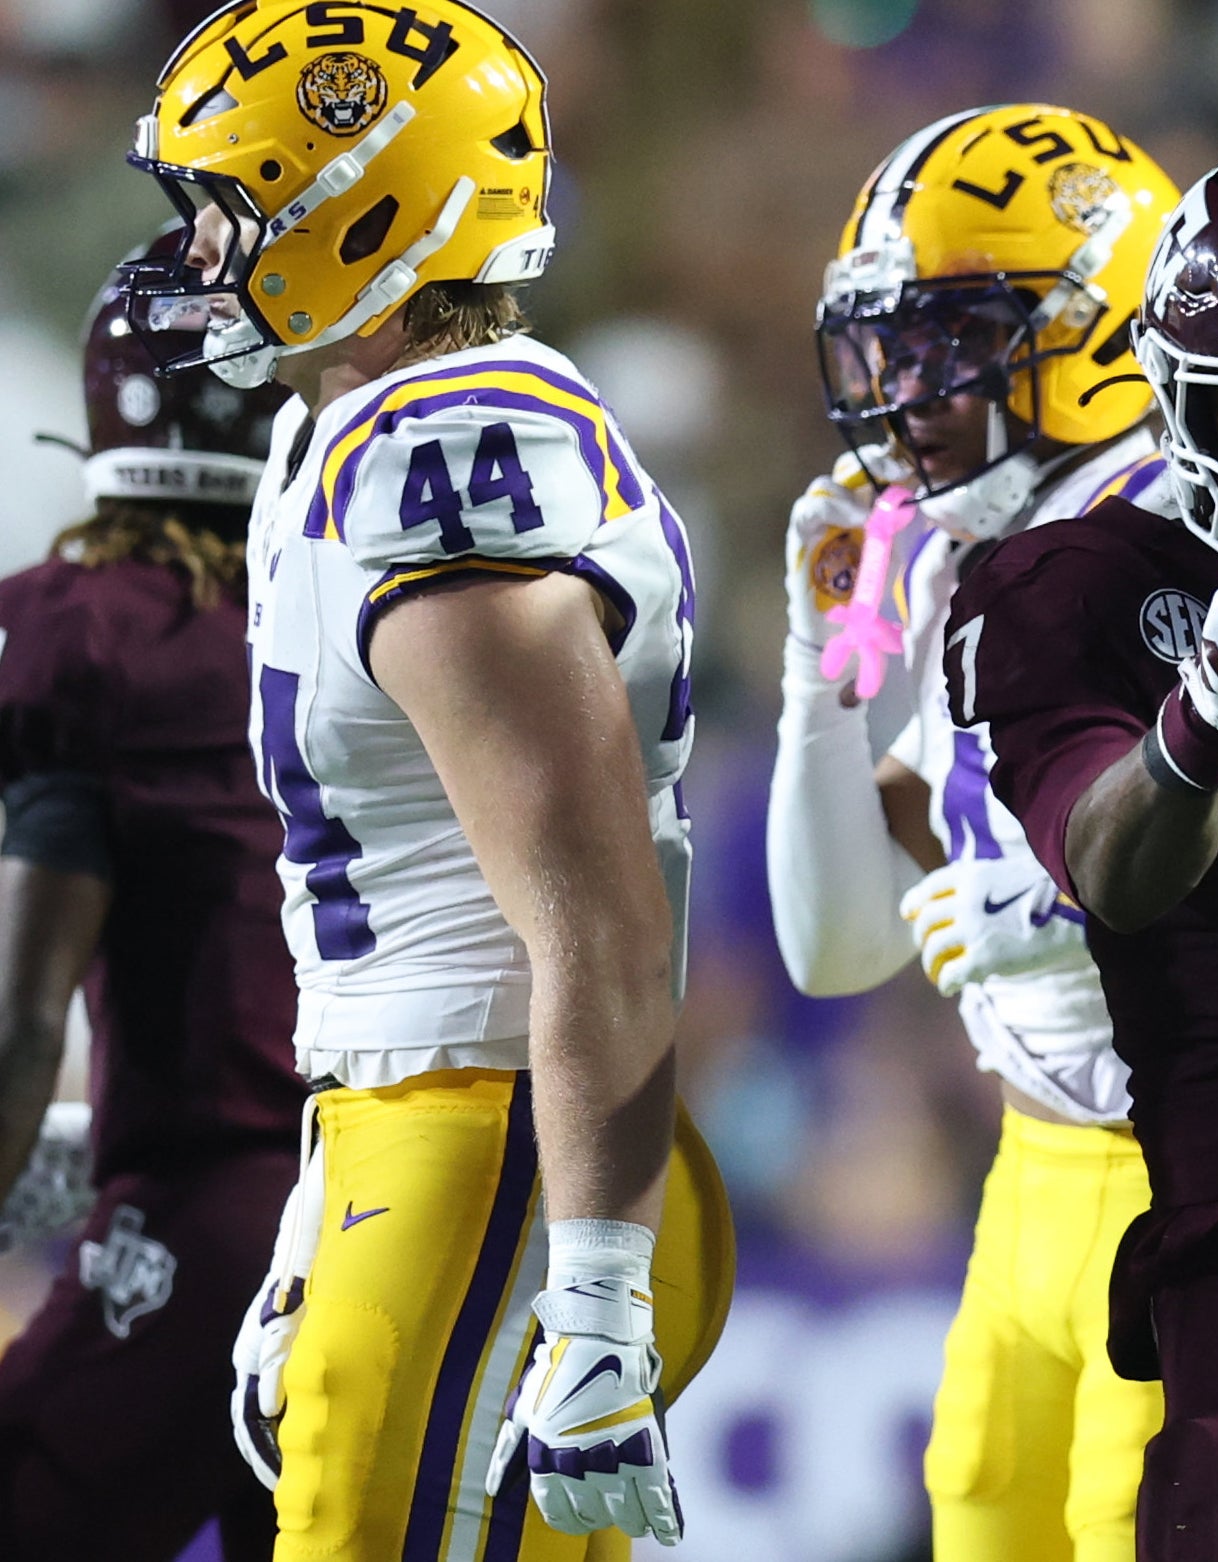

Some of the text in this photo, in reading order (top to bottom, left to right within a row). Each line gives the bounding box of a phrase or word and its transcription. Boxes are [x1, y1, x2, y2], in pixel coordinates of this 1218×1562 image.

[223, 1, 460, 83] LSU
[953, 116, 1132, 211] LSU
[400, 423, 541, 554] 44
